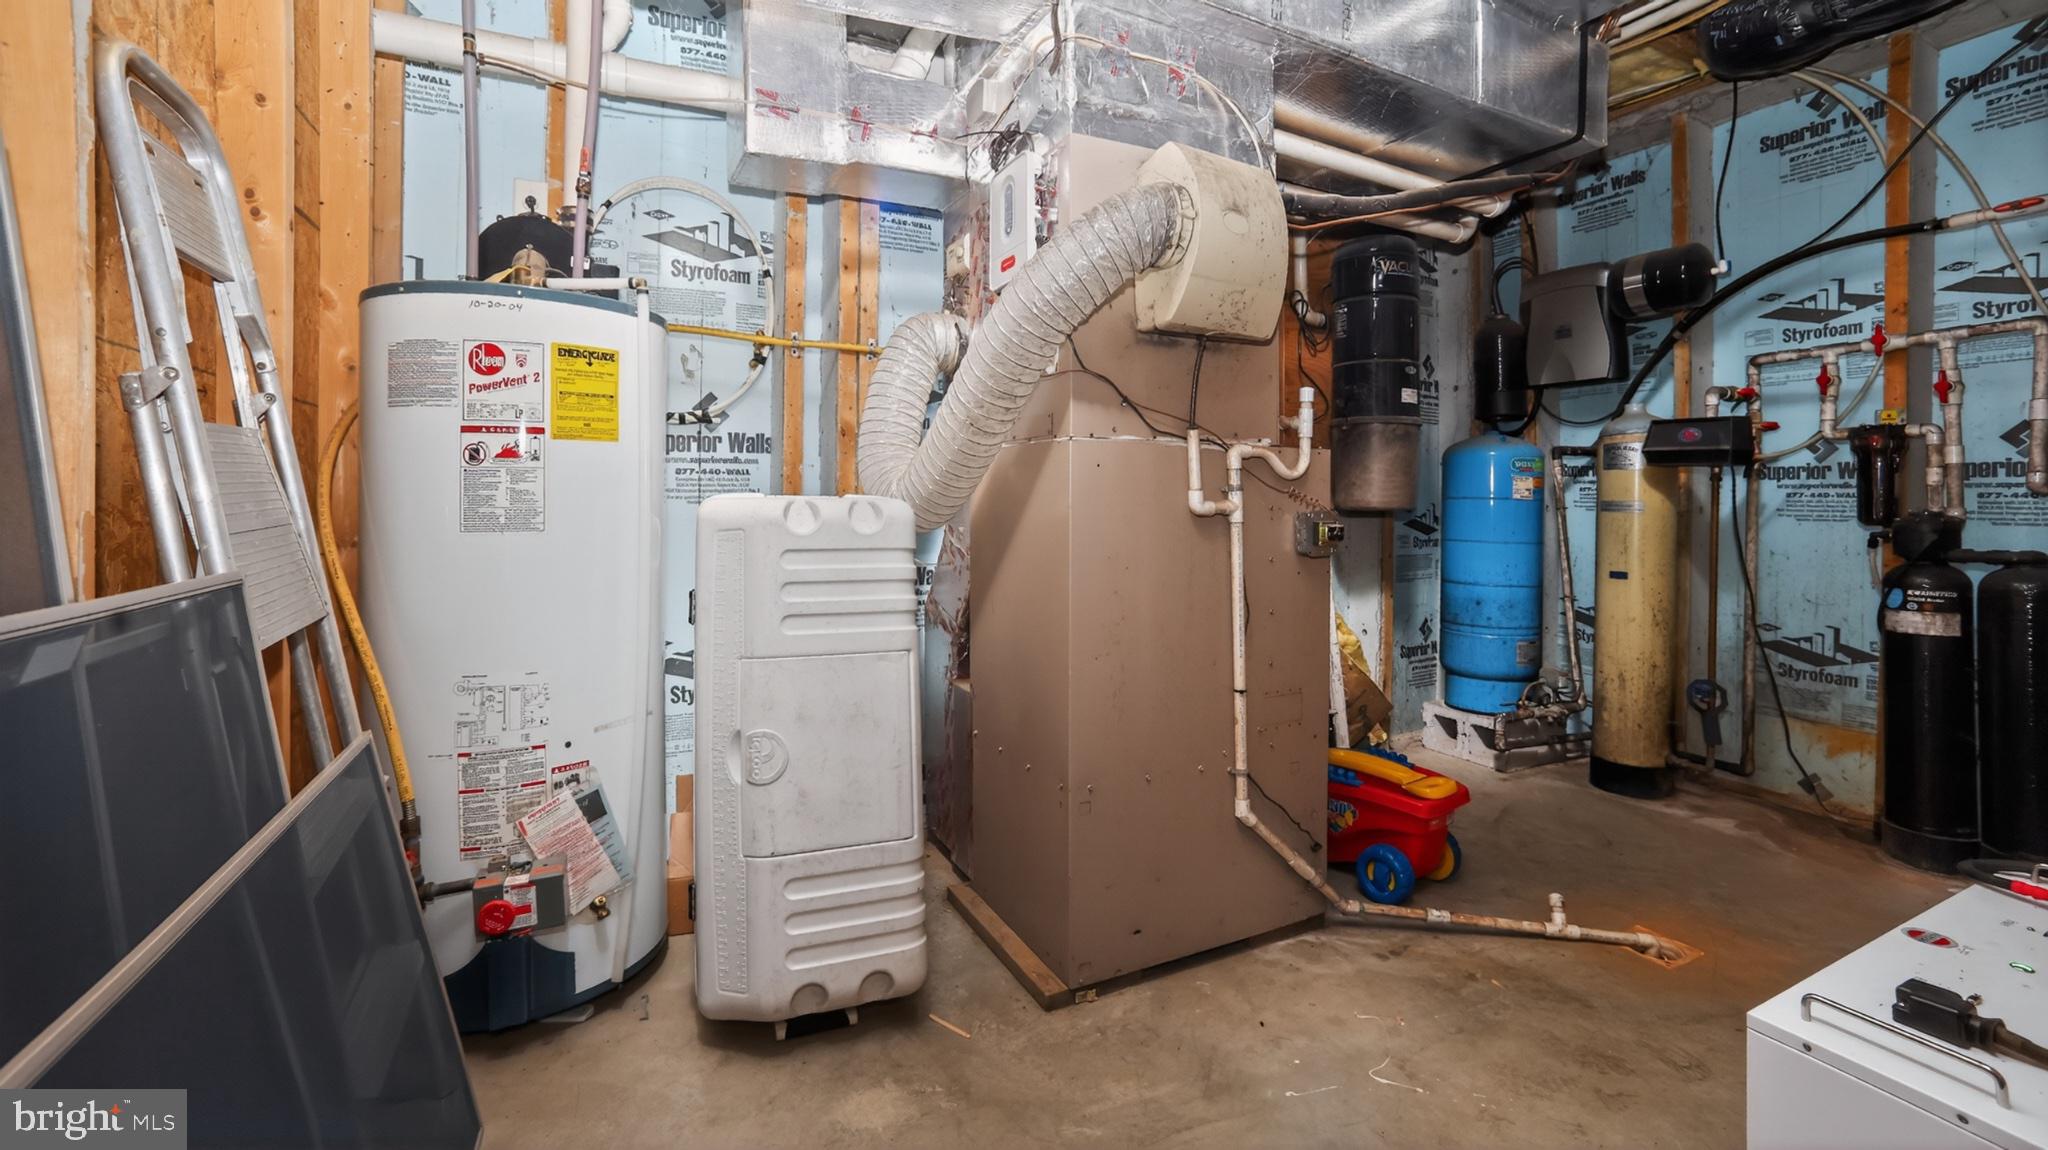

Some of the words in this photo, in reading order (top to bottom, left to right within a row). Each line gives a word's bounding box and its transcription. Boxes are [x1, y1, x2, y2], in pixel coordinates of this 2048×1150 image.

[648, 5, 726, 39] Superior
[1760, 118, 1836, 153] Superior
[1611, 170, 1646, 191] Walls
[671, 259, 751, 284] Styrofoam
[1782, 322, 1863, 344] Styrofoam
[469, 375, 527, 394] PowerVent
[533, 372, 541, 382] 2
[665, 433, 722, 455] perior
[727, 431, 772, 454] Walls
[1760, 462, 1832, 482] Superior
[1777, 662, 1859, 688] Styrofoam
